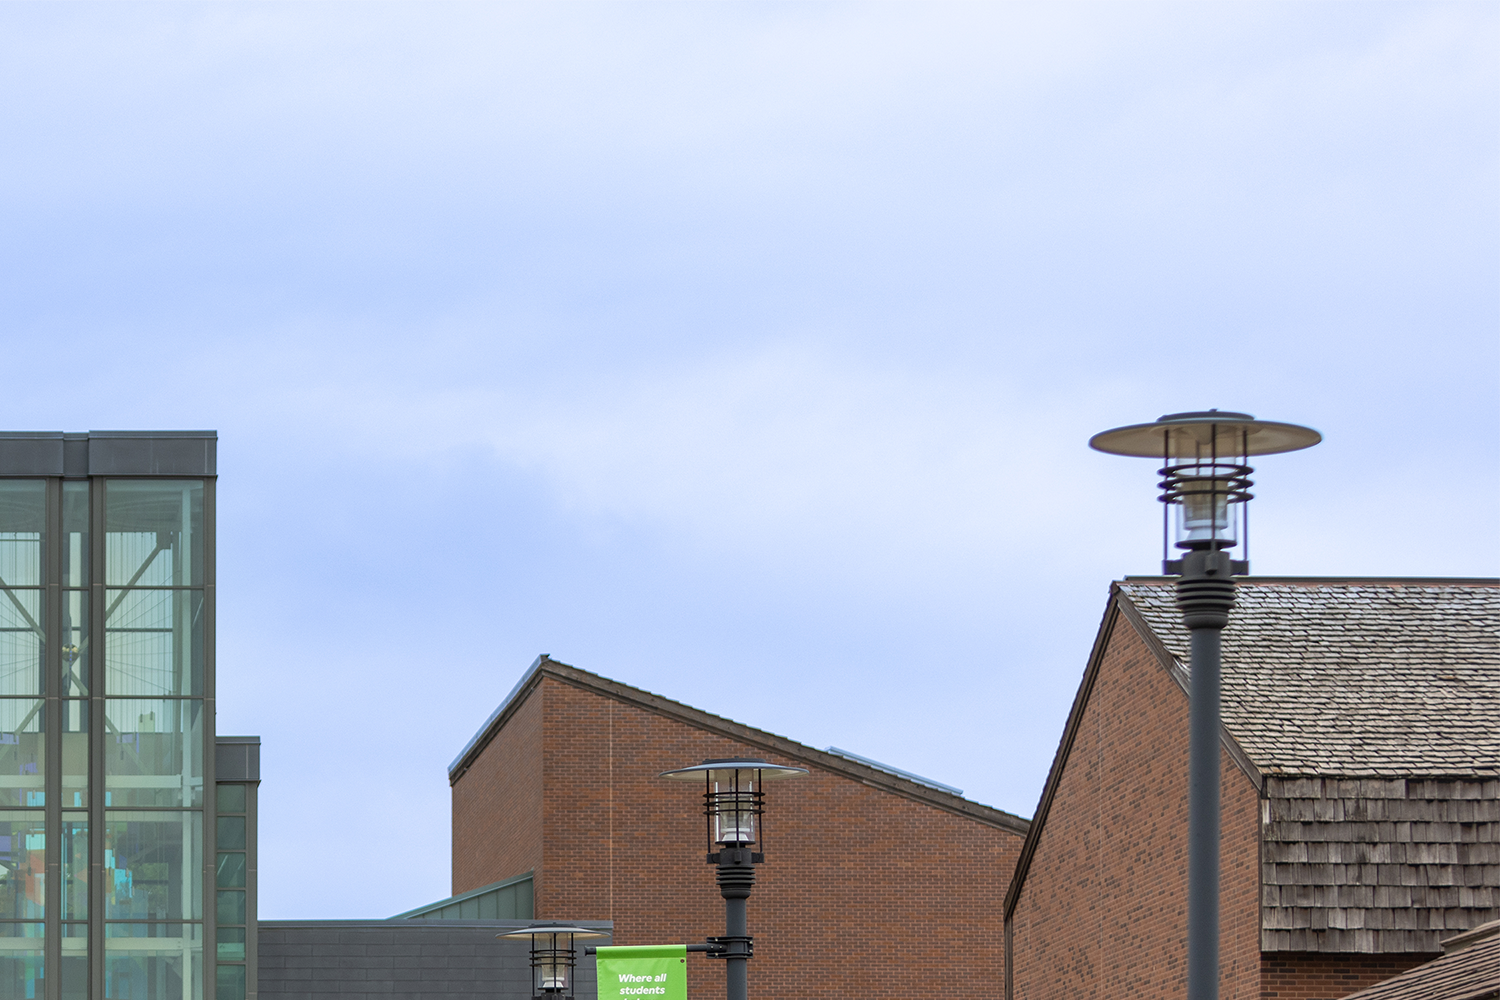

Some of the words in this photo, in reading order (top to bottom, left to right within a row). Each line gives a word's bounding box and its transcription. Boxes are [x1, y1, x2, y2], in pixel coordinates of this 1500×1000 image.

[618, 973, 653, 983] Where
[654, 973, 667, 983] all
[619, 986, 666, 995] students
